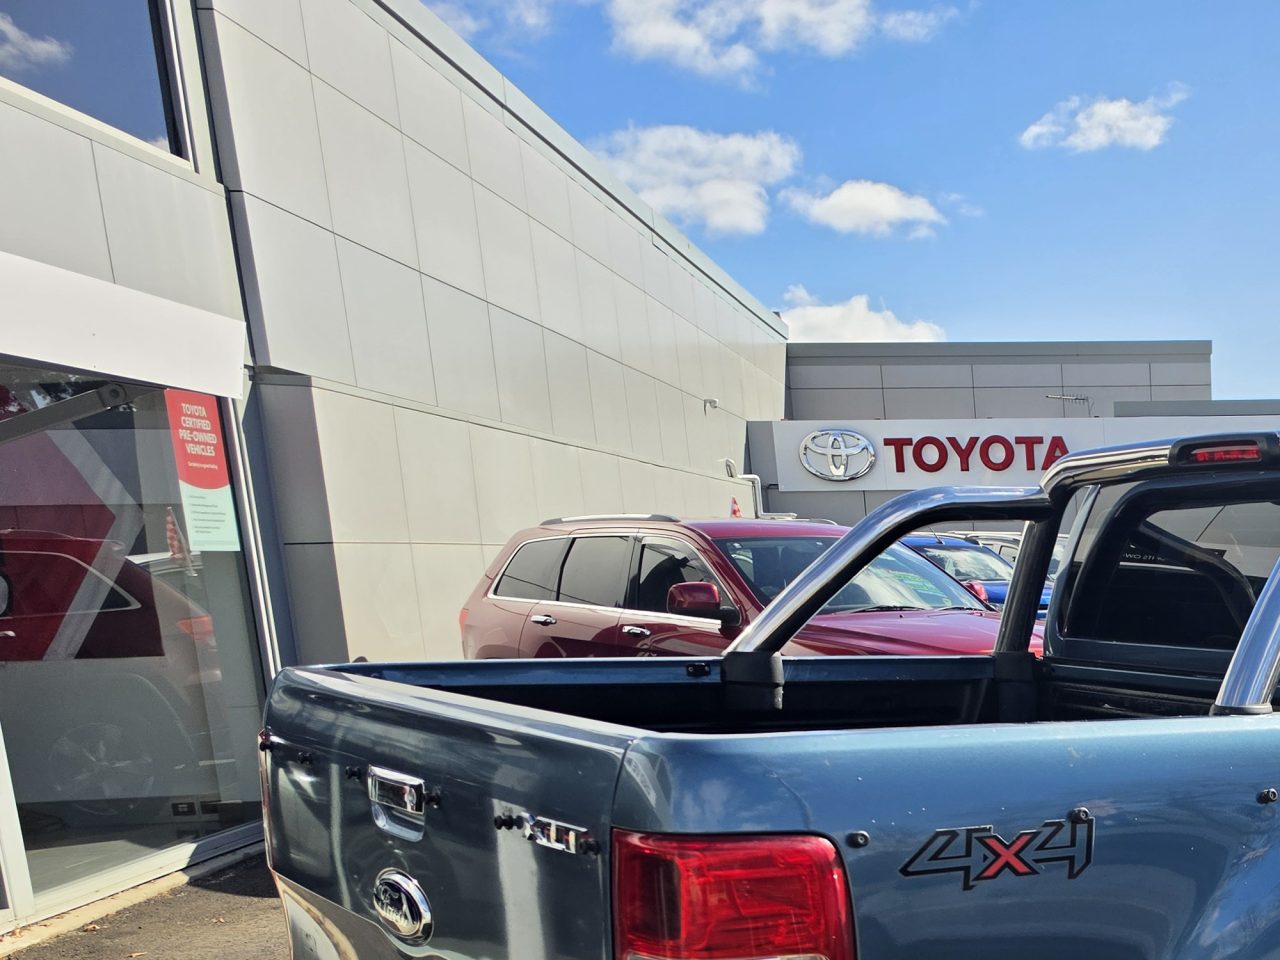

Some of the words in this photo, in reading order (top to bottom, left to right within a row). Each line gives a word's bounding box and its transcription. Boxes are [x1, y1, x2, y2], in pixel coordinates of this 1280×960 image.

[181, 403, 207, 417] TOYOTA
[181, 416, 211, 430] CERTIFIED
[179, 429, 217, 443] PRE-OWNED
[185, 443, 215, 456] VEHICLES
[883, 435, 1069, 473] TOYOTA
[520, 811, 588, 854] XLT
